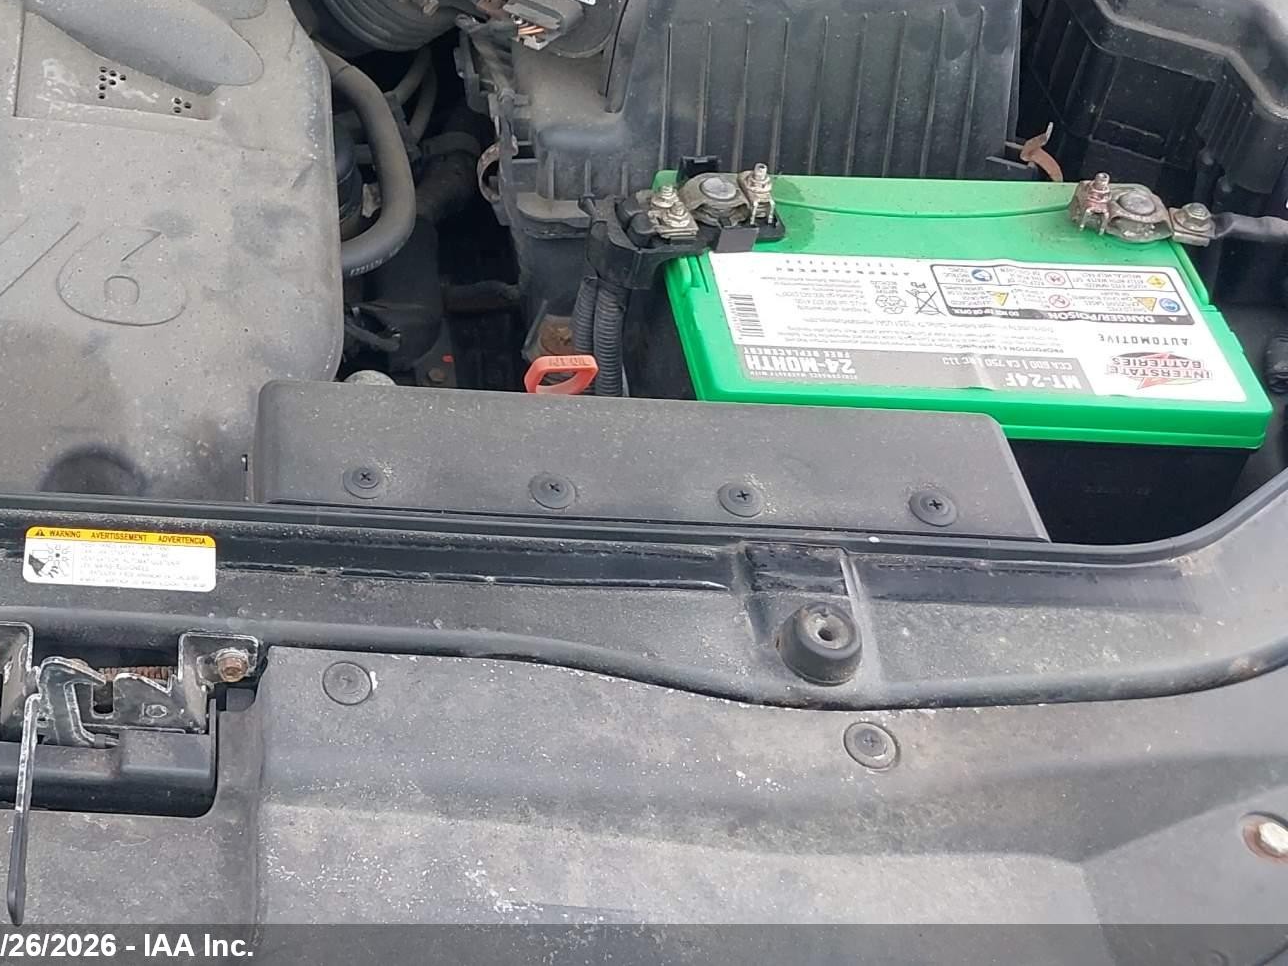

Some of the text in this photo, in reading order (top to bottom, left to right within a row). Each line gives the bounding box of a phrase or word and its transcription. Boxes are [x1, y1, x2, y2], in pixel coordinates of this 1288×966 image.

[1048, 312, 1156, 323] DANGER/POISON
[1098, 334, 1189, 346] AUTOMOTIVE
[743, 346, 820, 357] REPLACEMENT
[744, 354, 856, 374] 24-MONTH
[1006, 358, 1021, 368] CA
[1051, 360, 1072, 371] CCA
[1112, 357, 1202, 369] BATTERIES
[1109, 365, 1211, 379] INTERSTATE
[1005, 371, 1082, 389] MT-24F
[49, 530, 206, 545] WARNING AVERTISSEMENT ADVERTENCIA
